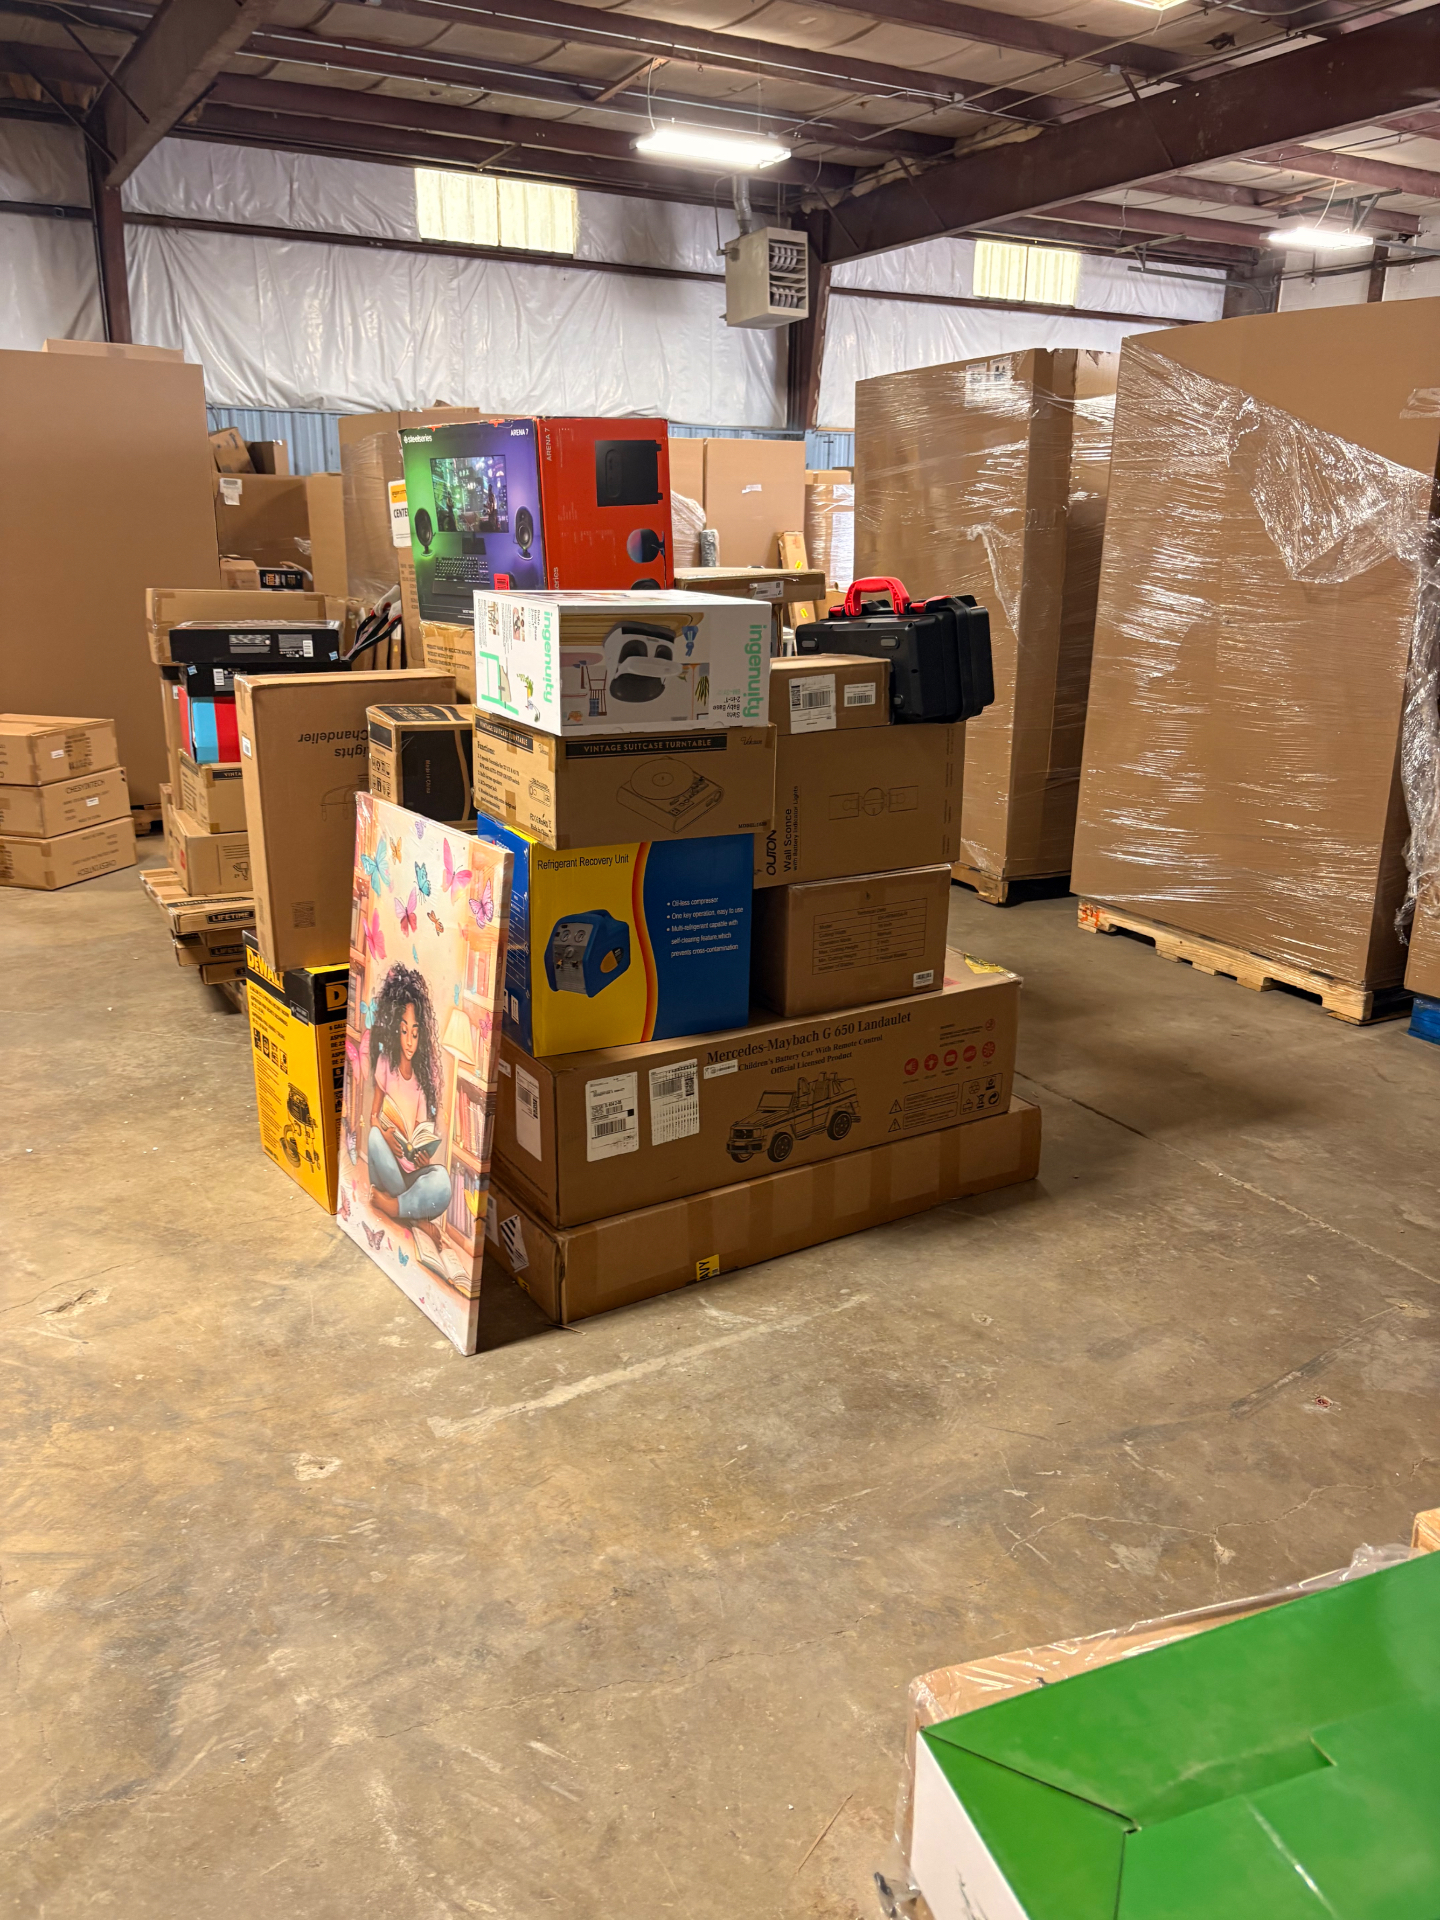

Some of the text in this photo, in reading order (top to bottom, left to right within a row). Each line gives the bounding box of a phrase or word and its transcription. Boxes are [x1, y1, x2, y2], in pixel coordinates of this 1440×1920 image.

[541, 611, 554, 703] ingenuity
[742, 624, 767, 718] ingenuity
[298, 729, 369, 744] Chandelier
[334, 744, 368, 759] ights
[583, 739, 711, 753] VINTAGE SUITCASE TURNTABLE
[783, 808, 792, 872] Wall Sconce
[766, 829, 777, 876] OUTON
[537, 854, 629, 871] Refrigerant Recovery Unit
[671, 897, 718, 907] Oil-less compressor
[212, 911, 250, 922] LIFETIME
[683, 911, 692, 919] key
[671, 922, 709, 932] Multi-refrigerant
[671, 944, 738, 958] prevents cross-contamination
[706, 1011, 911, 1064] Mercedes-Maybach G 650 Landaulet
[738, 1057, 774, 1072] Children's
[775, 1053, 799, 1065] Battery
[801, 1049, 814, 1058] Car
[815, 1046, 832, 1055] With
[833, 1041, 857, 1051] Remote
[858, 1034, 883, 1046] Control
[770, 1051, 853, 1075] Official Licensed Product
